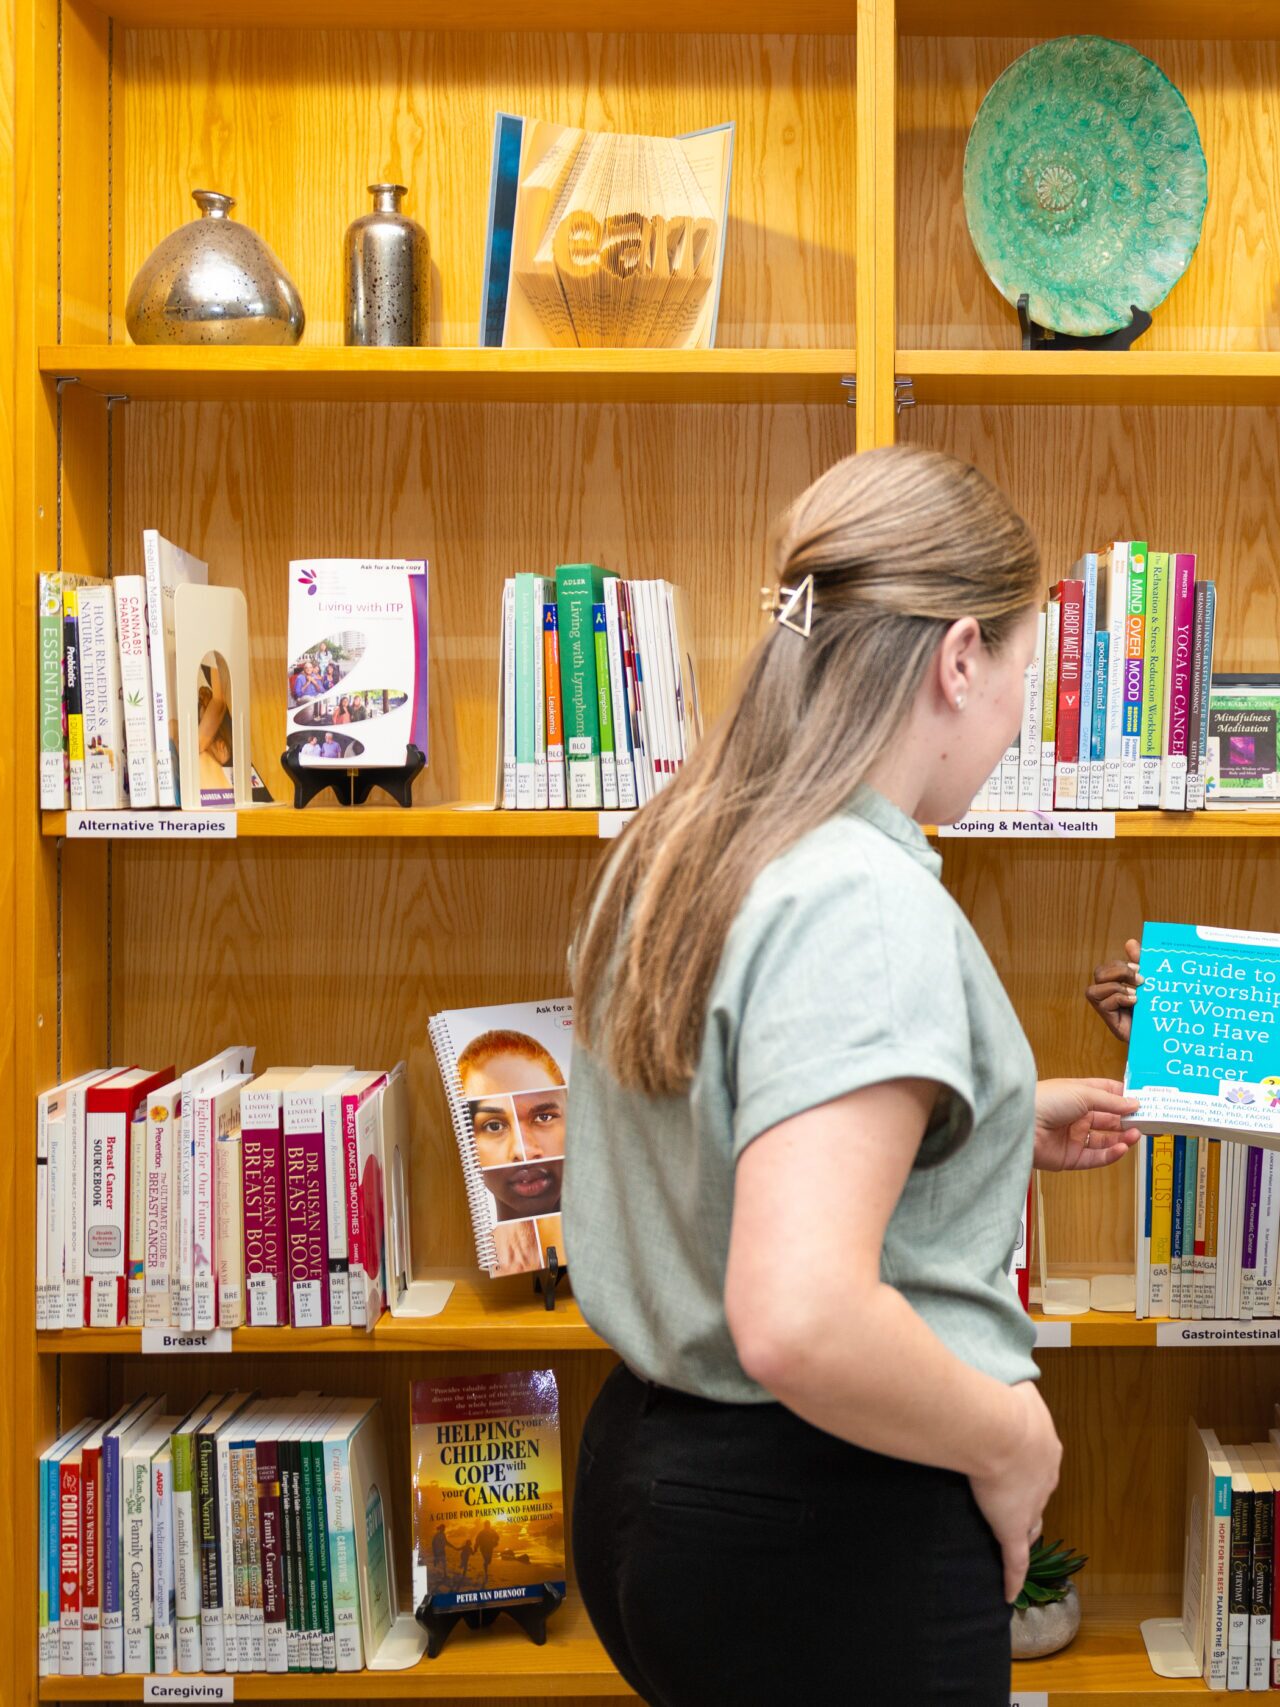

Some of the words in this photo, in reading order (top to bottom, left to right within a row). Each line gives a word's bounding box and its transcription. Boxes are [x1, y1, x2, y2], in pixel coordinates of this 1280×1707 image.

[1131, 579, 1143, 614] MIND
[1152, 567, 1161, 614] Relaxation
[318, 602, 352, 613] Living
[356, 603, 382, 612] with
[386, 603, 403, 612] ITP
[569, 601, 581, 638] Living
[1064, 602, 1079, 635] GABOR
[81, 601, 92, 659] NATURAL
[94, 605, 103, 645] HOME
[120, 598, 131, 655] PHARMACY
[130, 597, 141, 655] CANNABIS
[1129, 618, 1142, 655] OVER
[1151, 626, 1159, 653] Stress
[571, 642, 581, 669] with
[1063, 635, 1080, 659] MATÉ
[1176, 625, 1189, 669] YOGA
[43, 628, 58, 726] ESSENTIAL
[67, 646, 75, 688] Probiotics
[96, 649, 107, 713] REMEDIES
[1062, 661, 1078, 681] M.D.
[1128, 662, 1139, 701] MOOD
[1149, 655, 1158, 705] Reduction
[1175, 671, 1190, 692] for
[84, 663, 97, 732] THERAPIES
[572, 672, 586, 738] Lymphoma
[99, 717, 107, 726] &
[1147, 705, 1156, 752] Workbook
[1214, 713, 1271, 723] Mindfulness
[1217, 724, 1268, 733] Meditation
[79, 820, 153, 831] Alternative
[159, 820, 225, 832] Therapies
[953, 821, 994, 831] Coping
[998, 822, 1007, 831] &
[1012, 821, 1053, 831] Mental
[1157, 959, 1173, 973] A
[1181, 961, 1246, 979] Guide
[1255, 966, 1276, 983] to
[536, 1006, 550, 1014] Ask
[1150, 998, 1182, 1012] for
[1190, 999, 1275, 1023] Women
[1153, 1017, 1205, 1035] Who
[1213, 1023, 1270, 1043] Have
[1163, 1039, 1253, 1062] Ovarian
[1166, 1060, 1248, 1081] Cancer
[106, 1137, 116, 1171] Breast
[263, 1148, 274, 1172] DR.
[348, 1142, 357, 1182] CANCER
[93, 1139, 102, 1207] SOURCEBOOK
[245, 1142, 260, 1220] BREAST
[106, 1174, 115, 1210] Cancer
[264, 1176, 275, 1226] SUSAN
[350, 1183, 359, 1235] SMOOTHIES
[163, 1336, 207, 1346] Breast
[1182, 1329, 1280, 1340] Gastrointestinal
[437, 1419, 521, 1444] HELPING
[521, 1418, 543, 1430] your
[199, 1441, 212, 1495] Changing
[441, 1440, 540, 1465] CHILDREN
[455, 1464, 505, 1485] COPE
[506, 1461, 526, 1471] with
[442, 1490, 464, 1500] your
[465, 1482, 540, 1506] CANCER
[62, 1495, 78, 1538] COOKIE
[201, 1498, 215, 1540] Normal
[436, 1512, 457, 1521] GUIDE
[460, 1509, 473, 1519] FOR
[475, 1506, 505, 1517] PARENTS
[508, 1505, 521, 1514] AND
[522, 1503, 553, 1514] FAMILIES
[507, 1515, 528, 1524] SECOND
[530, 1513, 553, 1522] EDITION
[263, 1512, 275, 1550] Family
[62, 1541, 77, 1573] CURE
[265, 1553, 277, 1612] Caregiving
[456, 1592, 478, 1603] PETER
[481, 1590, 493, 1600] VAN
[495, 1588, 526, 1599] DERNOOT
[151, 1686, 223, 1697] Caregiving
